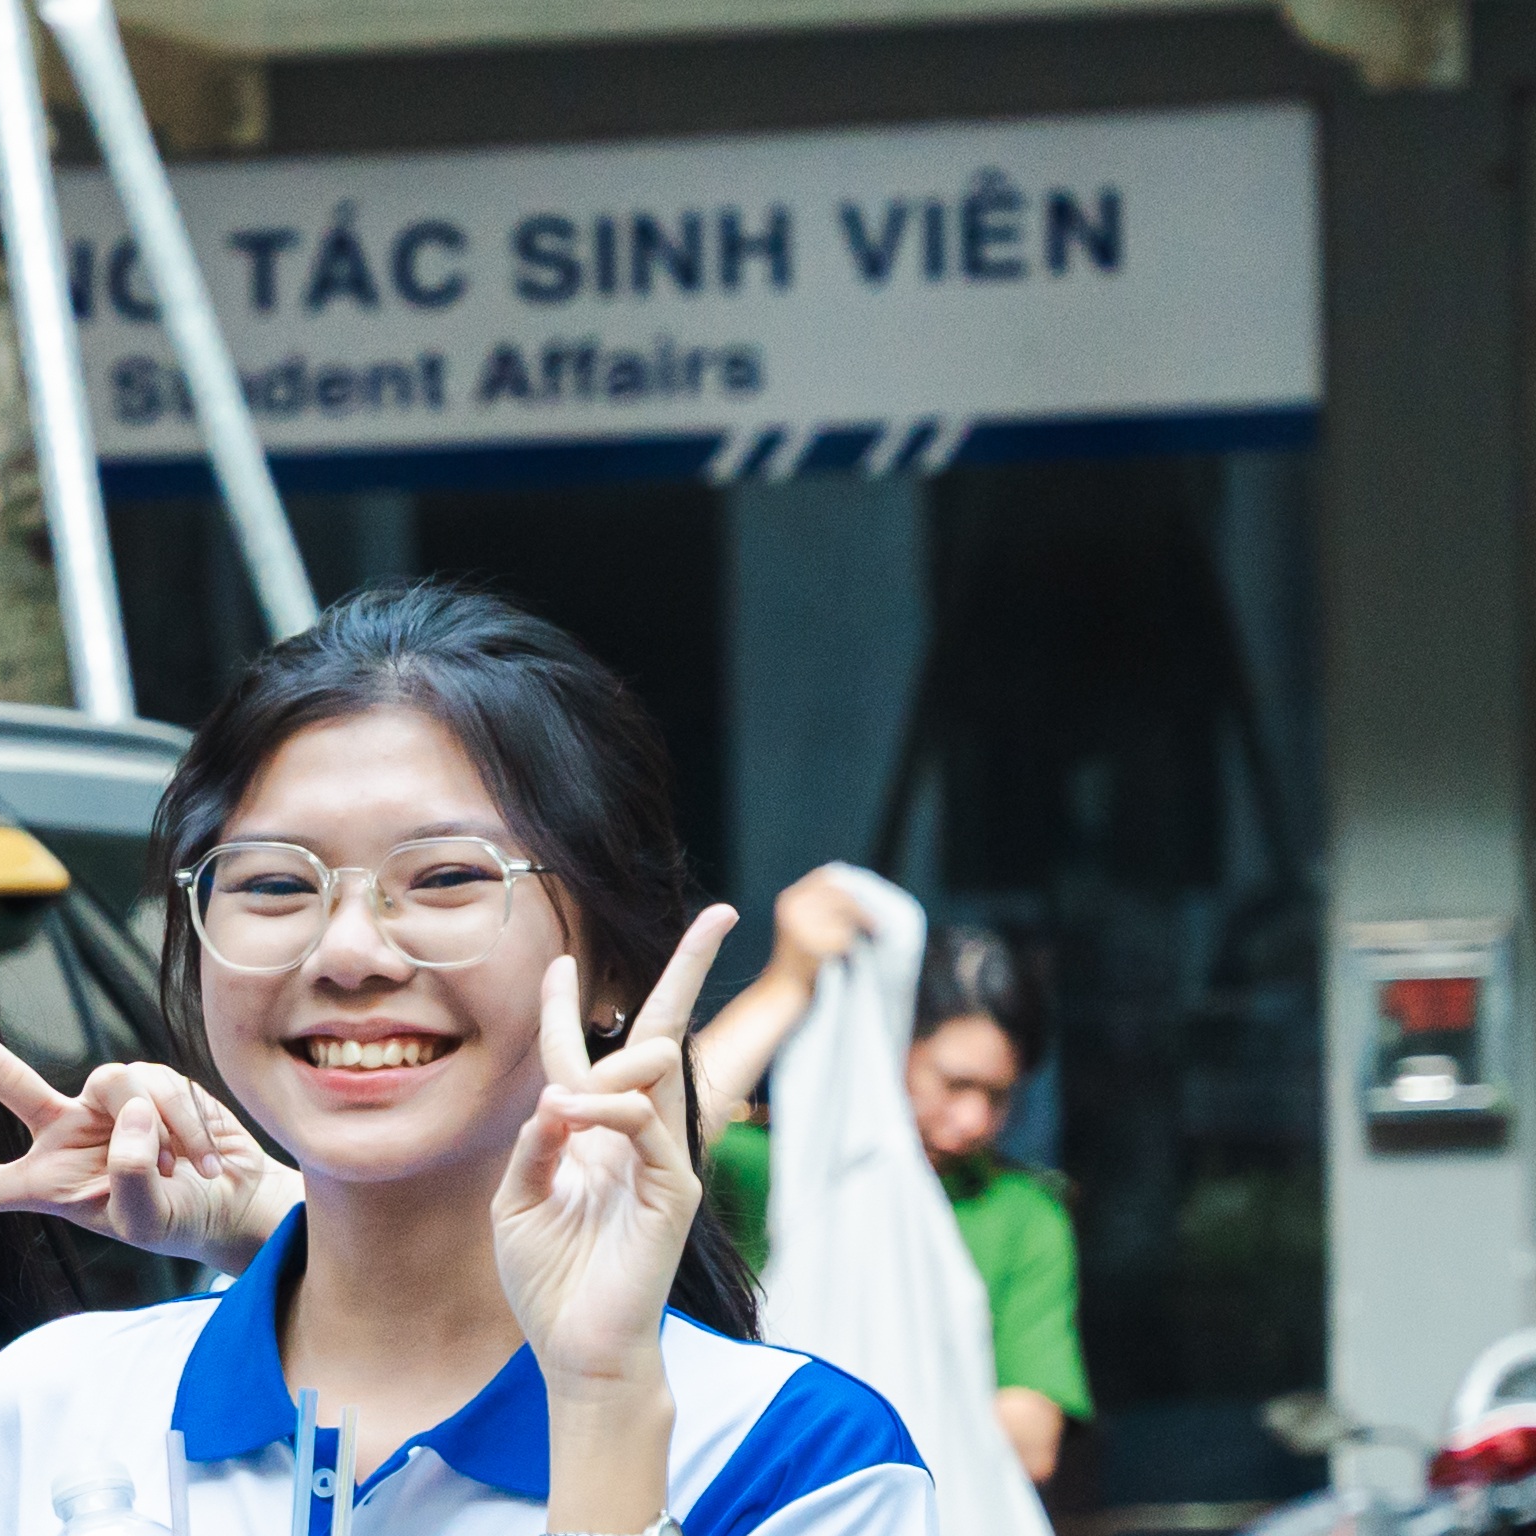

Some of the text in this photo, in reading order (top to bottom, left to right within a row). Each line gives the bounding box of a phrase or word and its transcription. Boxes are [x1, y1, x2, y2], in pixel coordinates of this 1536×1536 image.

[228, 198, 470, 315] TÁC
[512, 203, 794, 304] SINH
[837, 166, 1125, 290] VIÊN
[112, 332, 767, 427] Sdent Affairs
